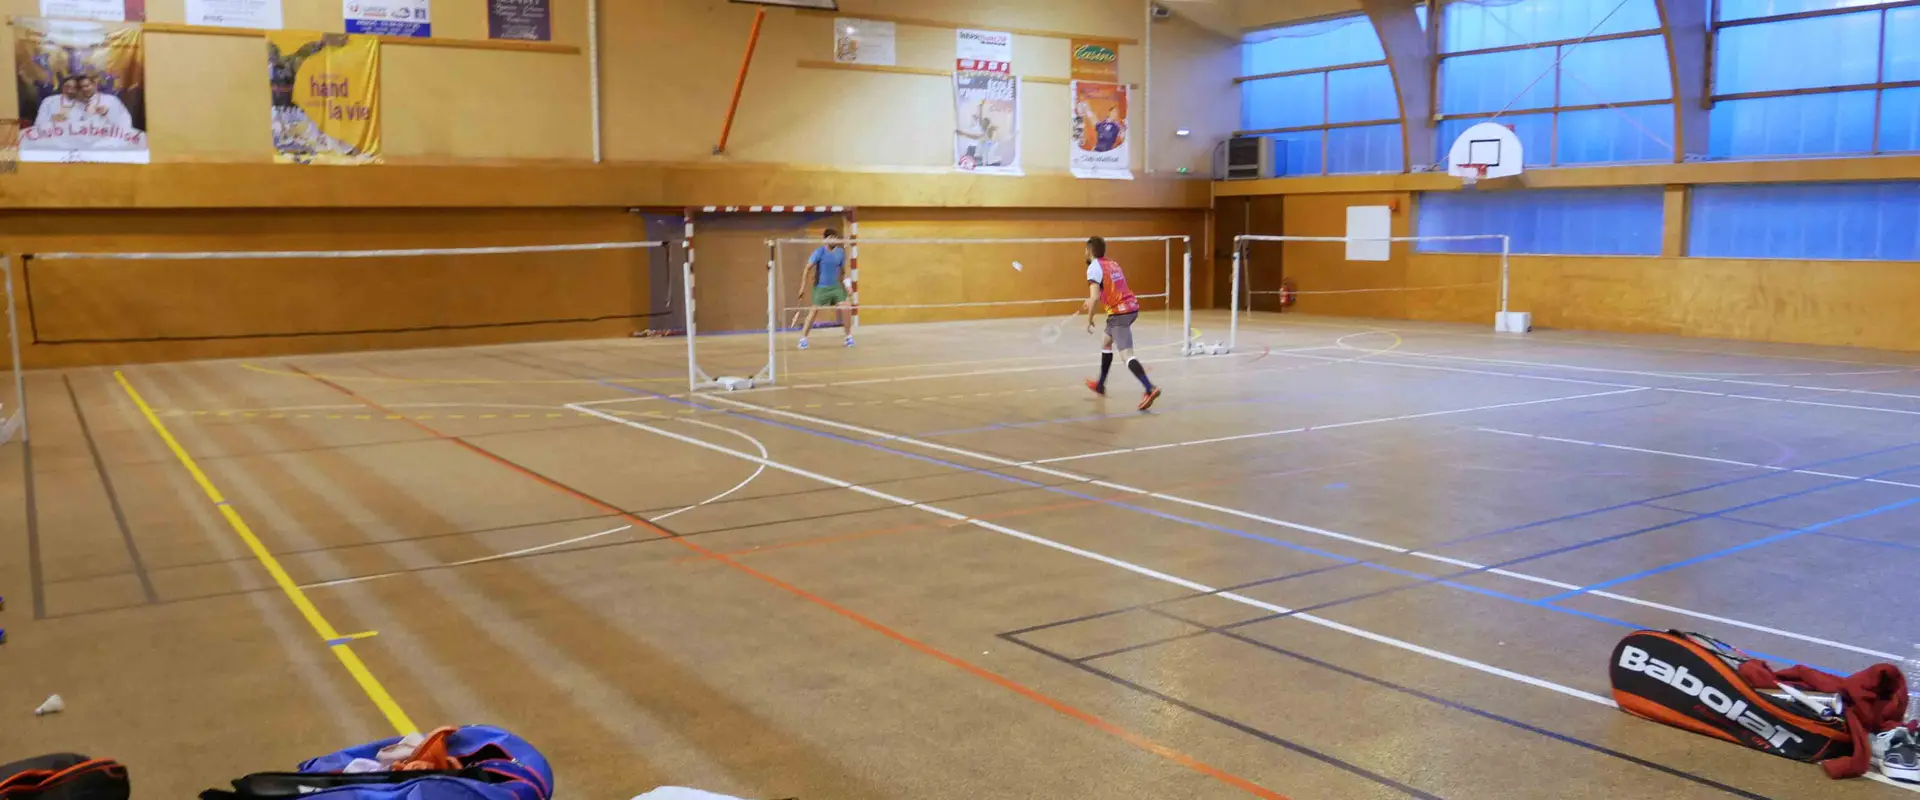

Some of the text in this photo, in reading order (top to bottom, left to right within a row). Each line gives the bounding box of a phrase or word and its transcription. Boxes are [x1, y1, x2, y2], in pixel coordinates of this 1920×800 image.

[1074, 44, 1116, 62] Casino
[310, 75, 349, 97] hand
[328, 100, 369, 121] la vie
[25, 122, 64, 140] Club
[1619, 645, 1803, 750] Babolat
